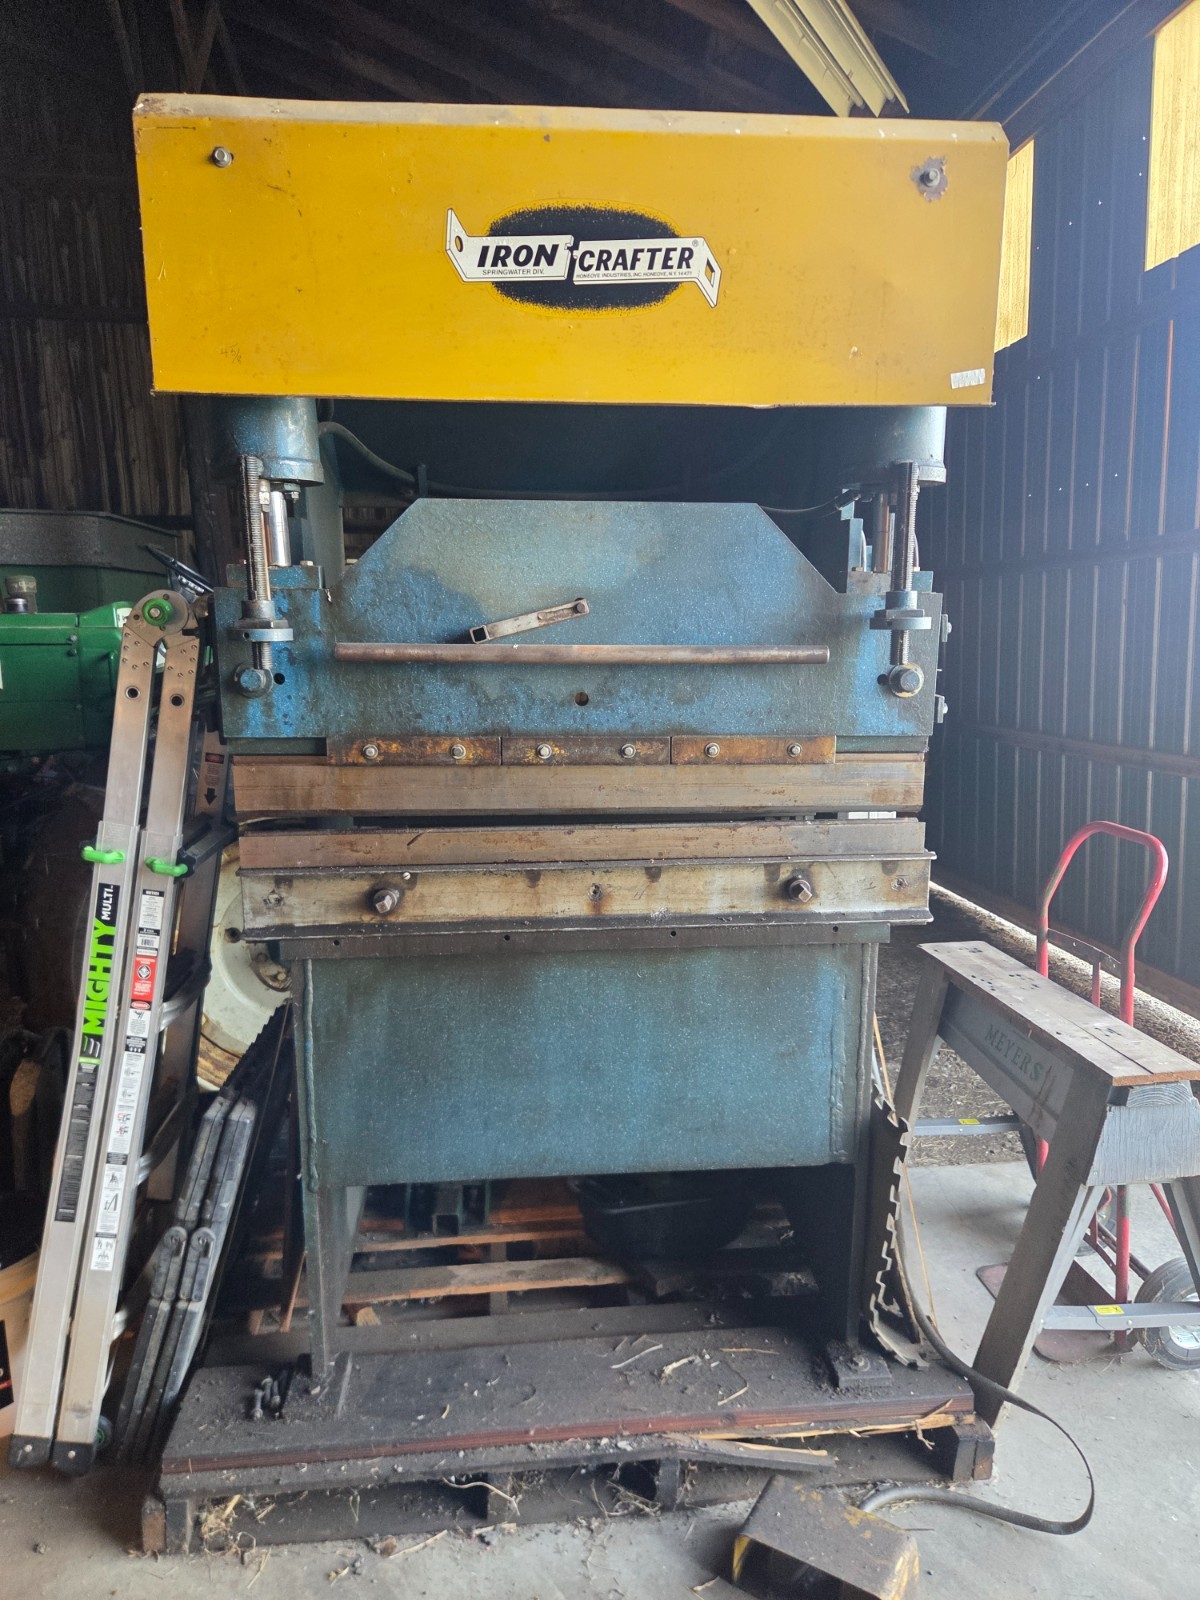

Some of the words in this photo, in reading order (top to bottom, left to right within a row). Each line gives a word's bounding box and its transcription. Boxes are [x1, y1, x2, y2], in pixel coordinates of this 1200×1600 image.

[477, 244, 560, 268] IRON
[82, 917, 116, 1035] MIGHTY
[985, 1024, 1043, 1081] MEYERS
